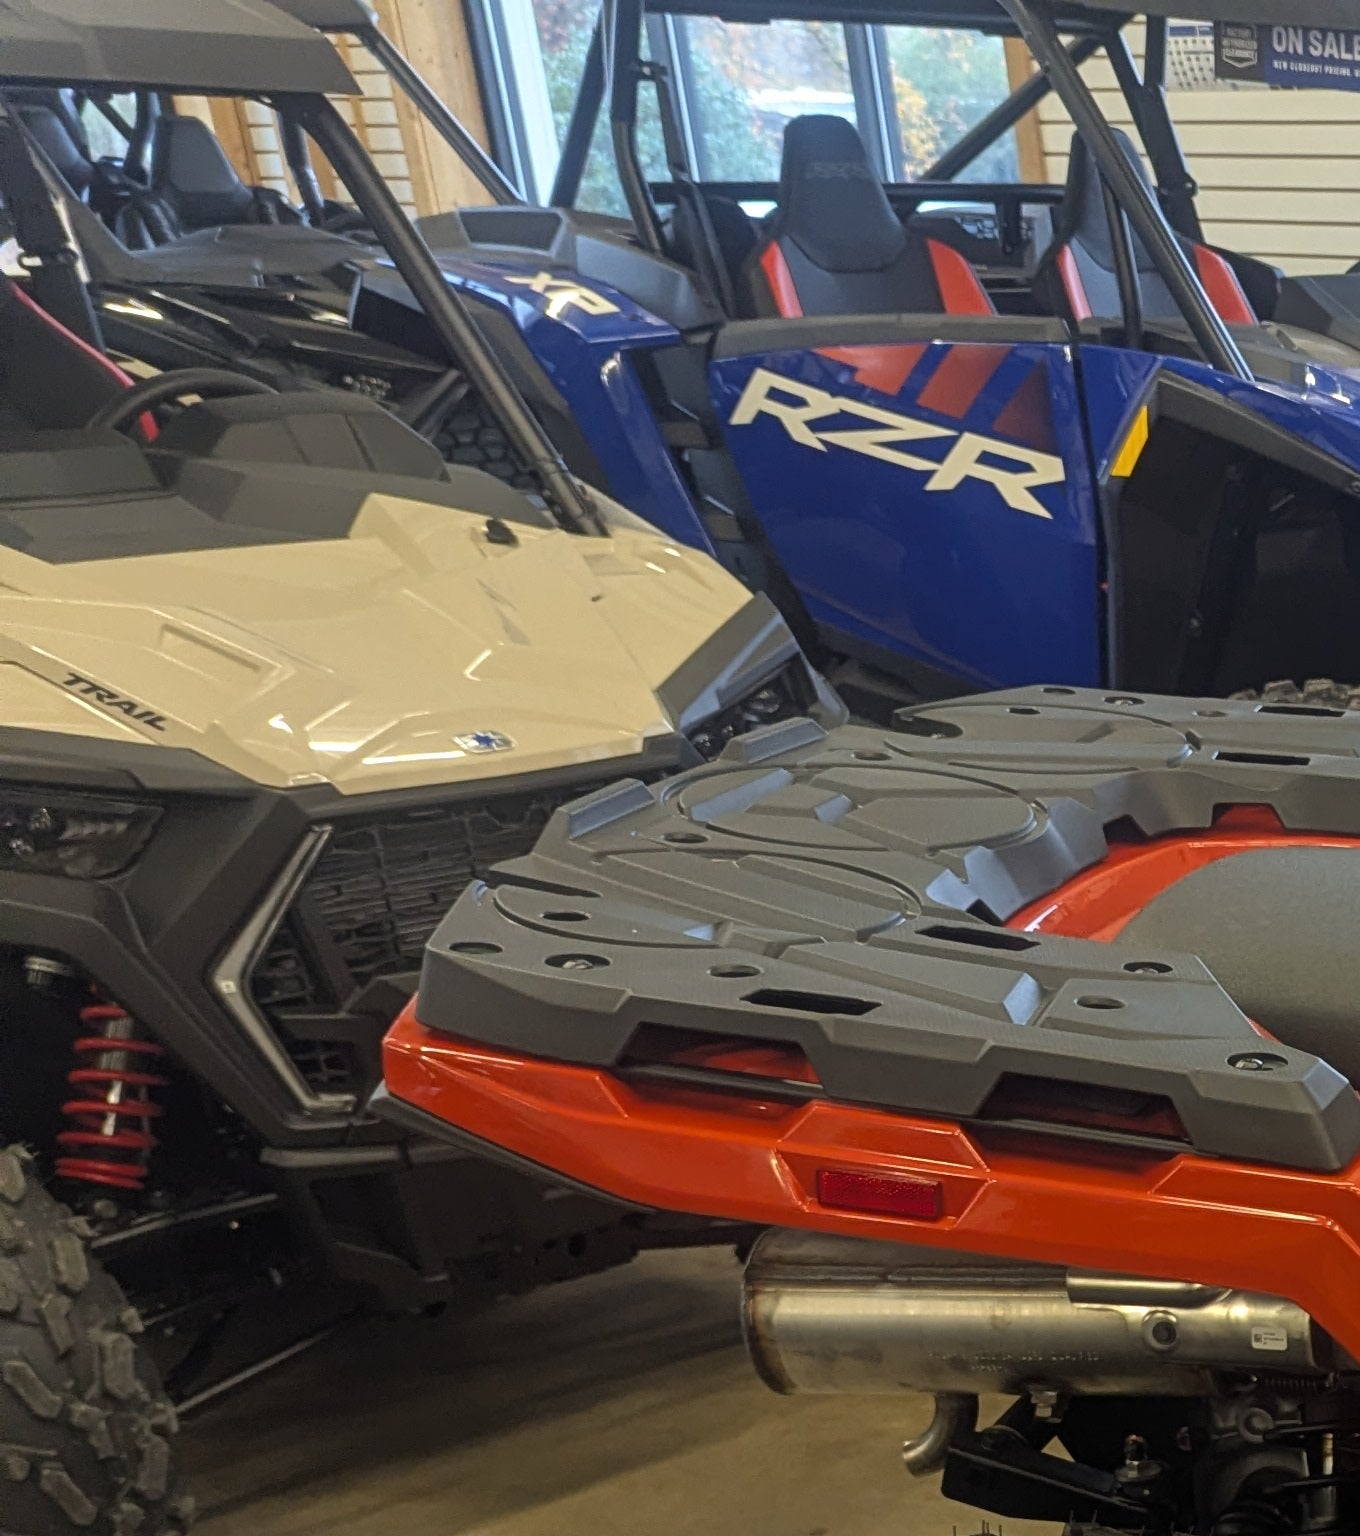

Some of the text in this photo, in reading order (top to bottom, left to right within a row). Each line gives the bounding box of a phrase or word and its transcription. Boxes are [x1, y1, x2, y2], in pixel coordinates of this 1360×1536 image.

[1272, 26, 1304, 56] ON
[503, 271, 621, 321] XP
[728, 367, 1066, 520] RZR
[63, 672, 167, 732] TRAIL
